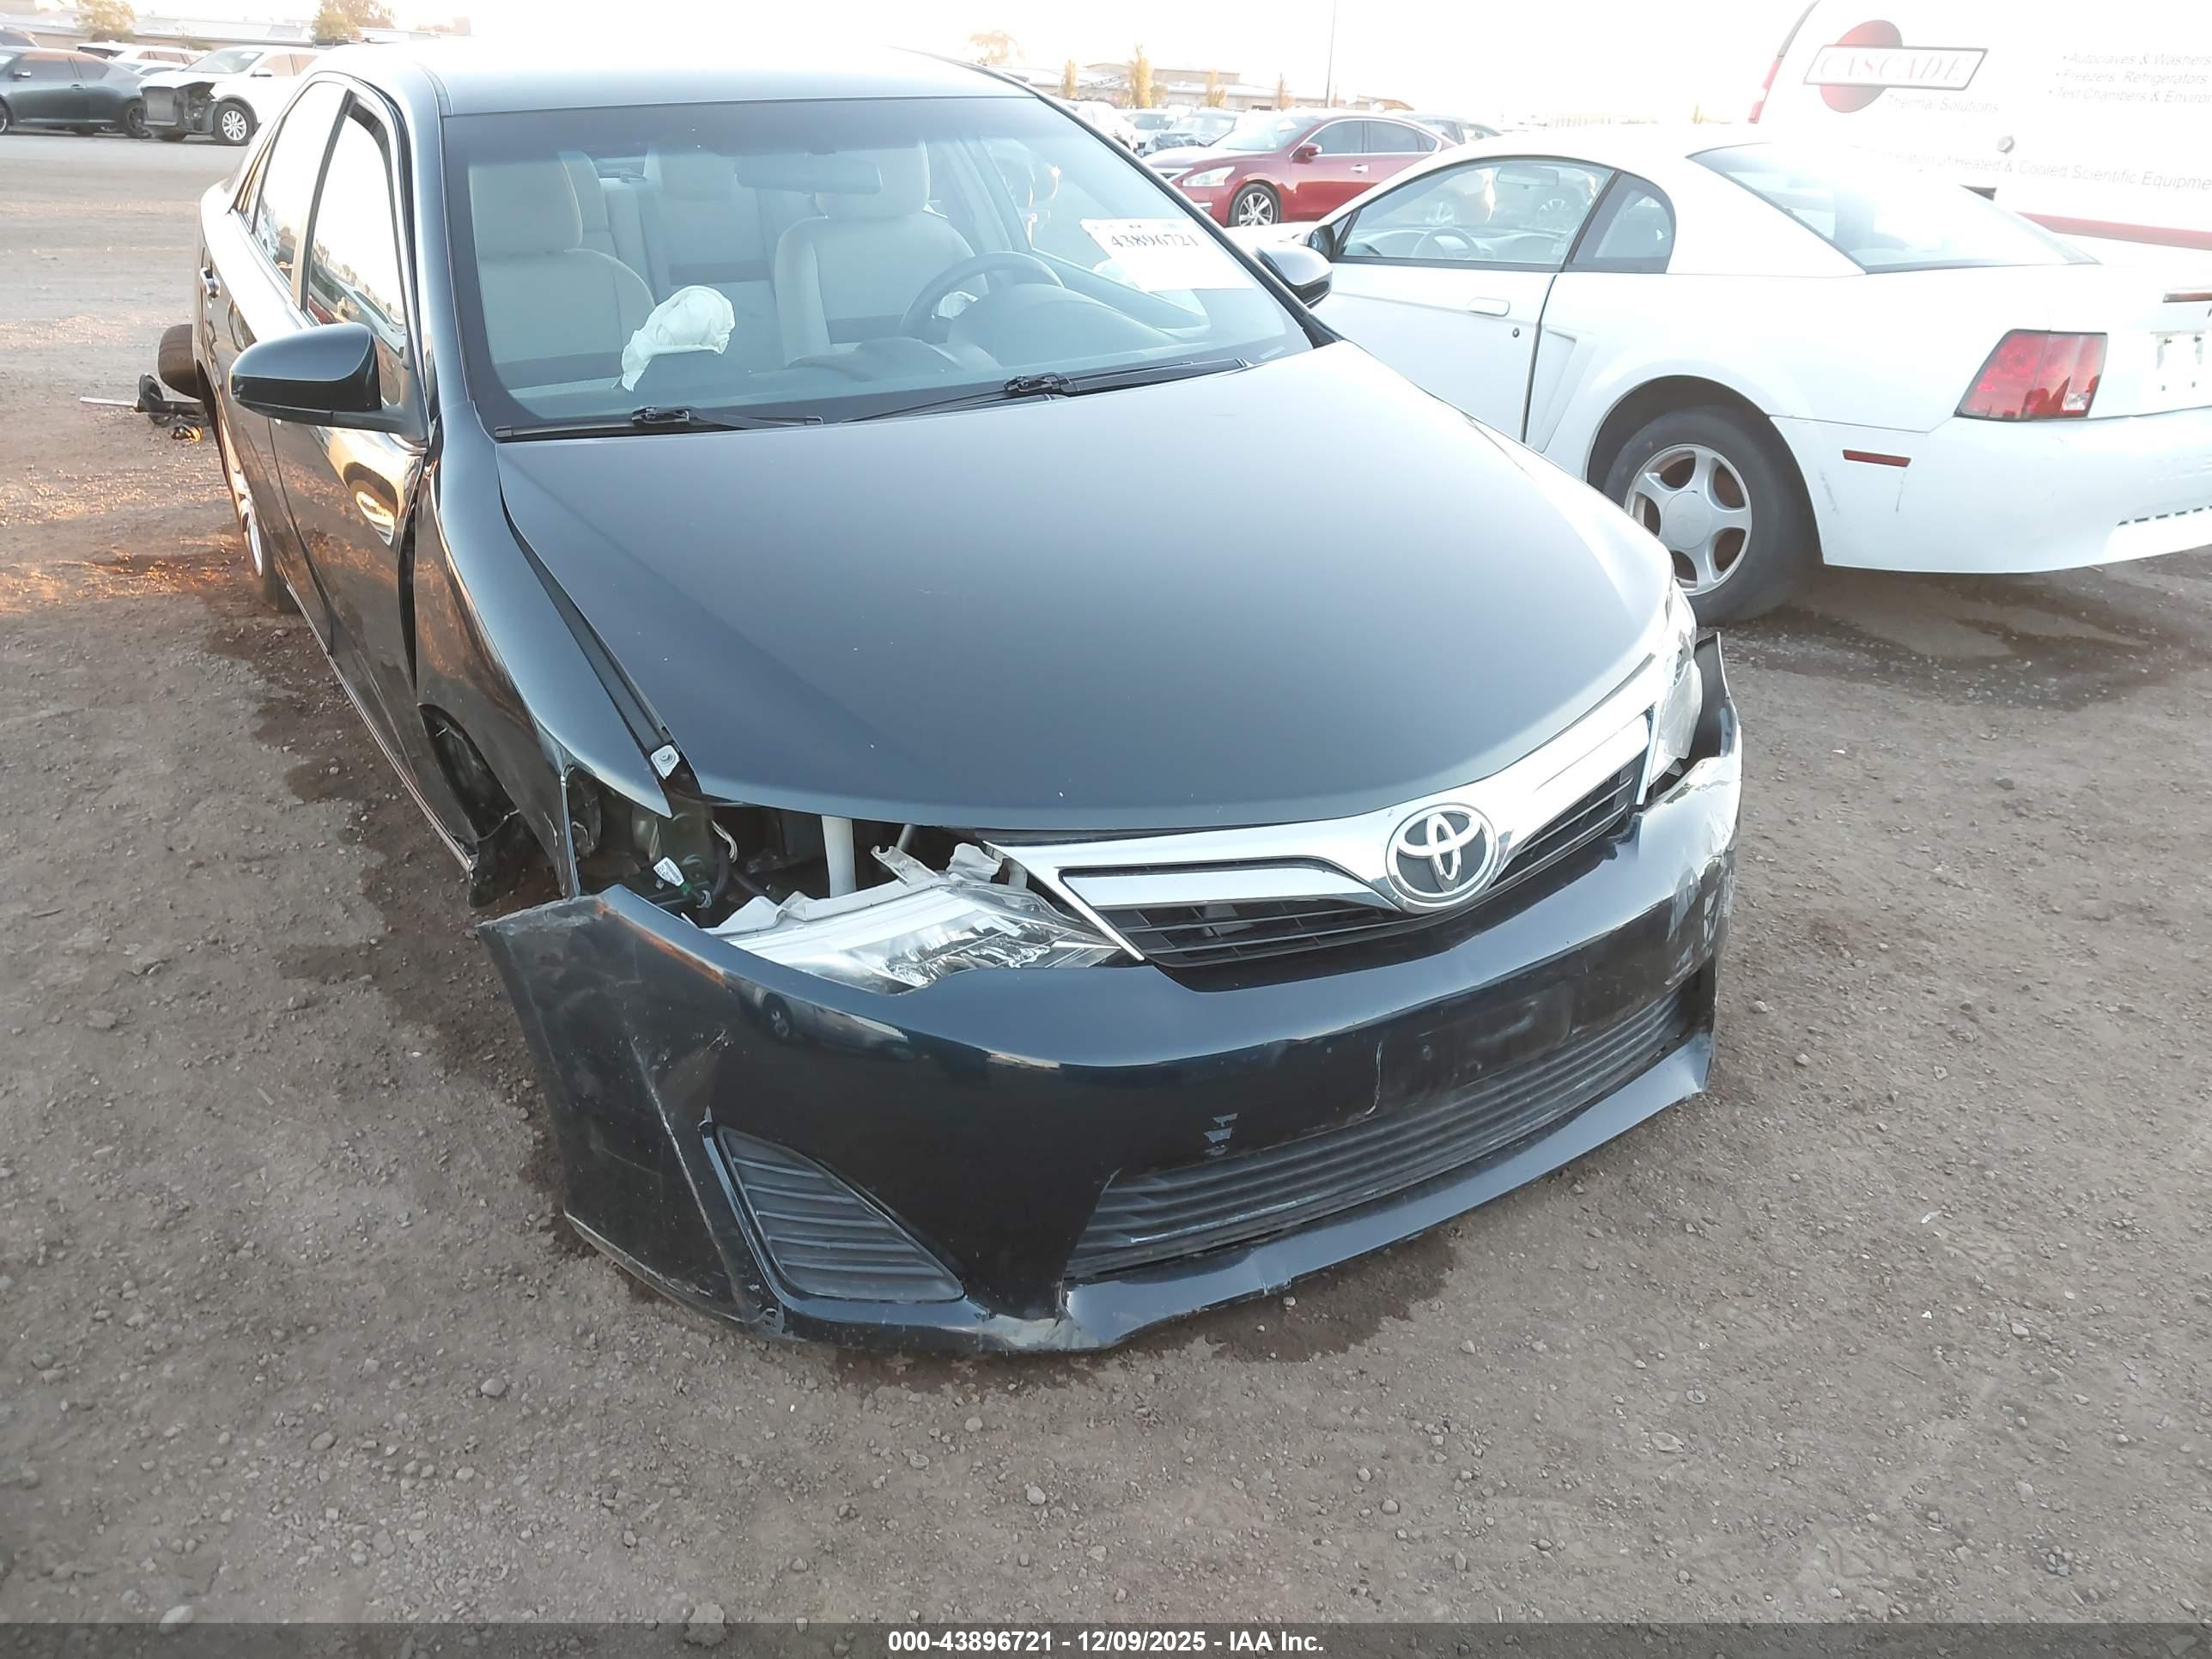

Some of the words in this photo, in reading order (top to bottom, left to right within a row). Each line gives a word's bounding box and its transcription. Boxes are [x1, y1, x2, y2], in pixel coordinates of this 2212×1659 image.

[1820, 54, 1967, 82] CASCADE
[2139, 52, 2150, 66] &
[2154, 53, 2212, 67] Washers
[2123, 70, 2209, 86] Refrigerators
[2057, 86, 2081, 100] Test
[2082, 88, 2147, 102] Chambers
[2149, 89, 2160, 103] &
[1887, 94, 1936, 110] Thermal
[1939, 96, 2000, 114] Solutions
[1954, 157, 2002, 173] Heated
[2002, 160, 2014, 173] &
[2019, 160, 2068, 179] Cooled
[2071, 165, 2137, 185] Scientific
[1111, 233, 1199, 248] 43896721
